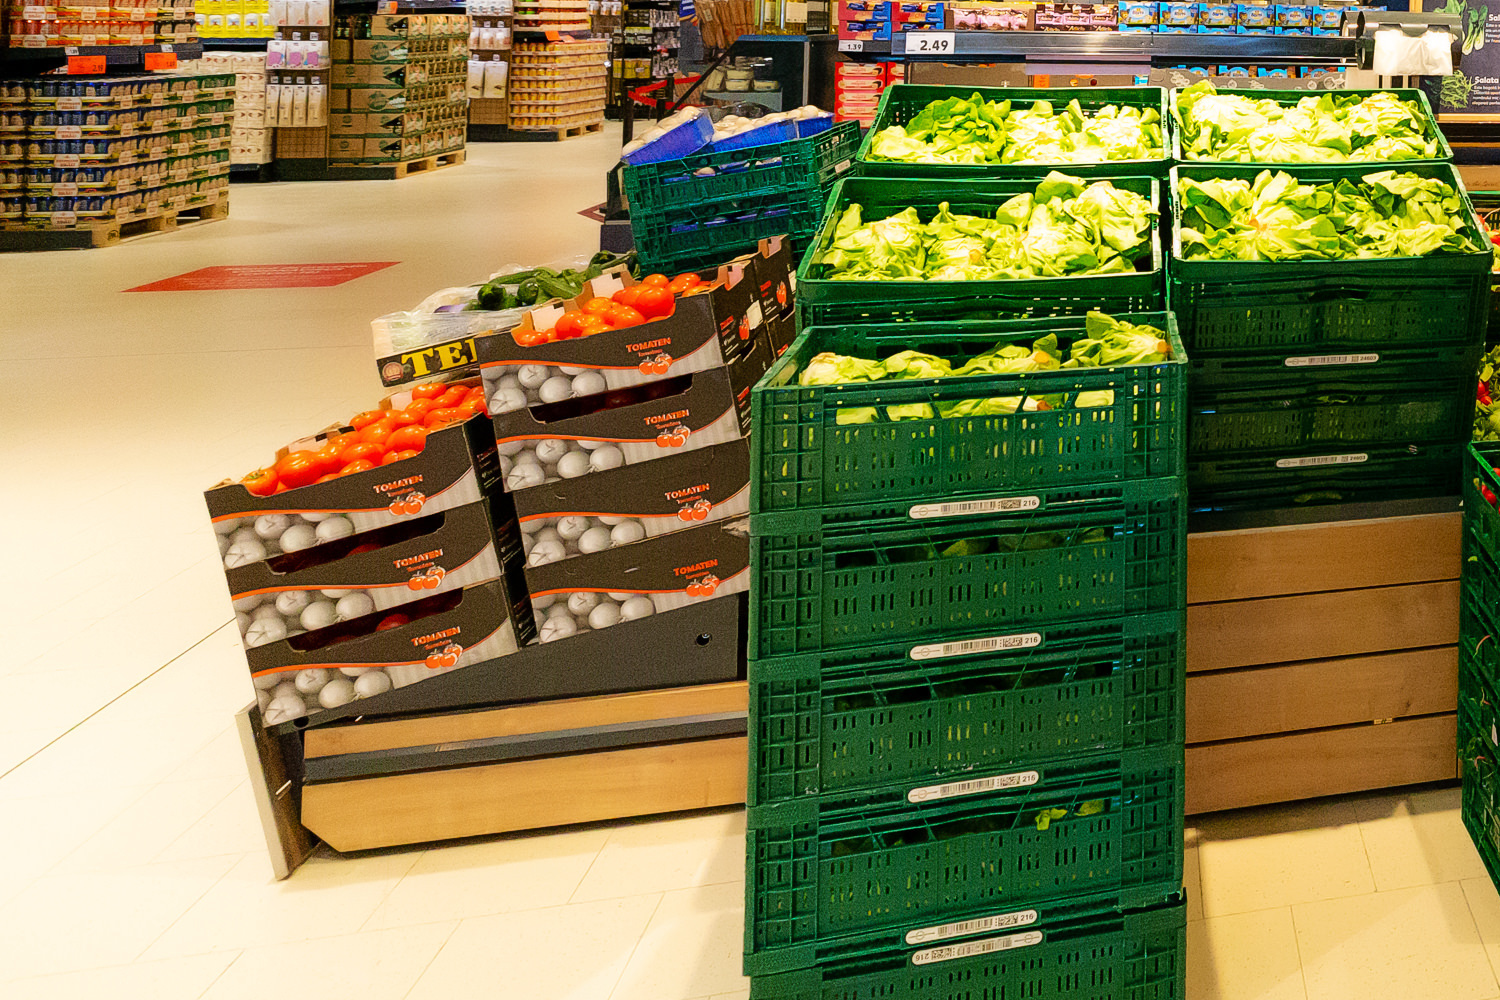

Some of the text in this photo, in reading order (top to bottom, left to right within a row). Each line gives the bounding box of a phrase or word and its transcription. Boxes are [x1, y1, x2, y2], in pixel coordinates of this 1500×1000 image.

[920, 40, 949, 51] 2.49
[1474, 76, 1499, 84] Salata
[626, 337, 672, 353] TOMATEN
[644, 408, 690, 425] TOMATEN
[373, 474, 424, 494] TOMATEN
[664, 482, 710, 500] TOMATEN
[1022, 499, 1037, 507] 216
[393, 548, 444, 569] TOMATEN
[673, 559, 719, 576] TOMATEN
[411, 626, 461, 647] TOMATEN
[1024, 636, 1038, 644] 216
[1022, 775, 1036, 783] 216
[1020, 913, 1034, 922] 216
